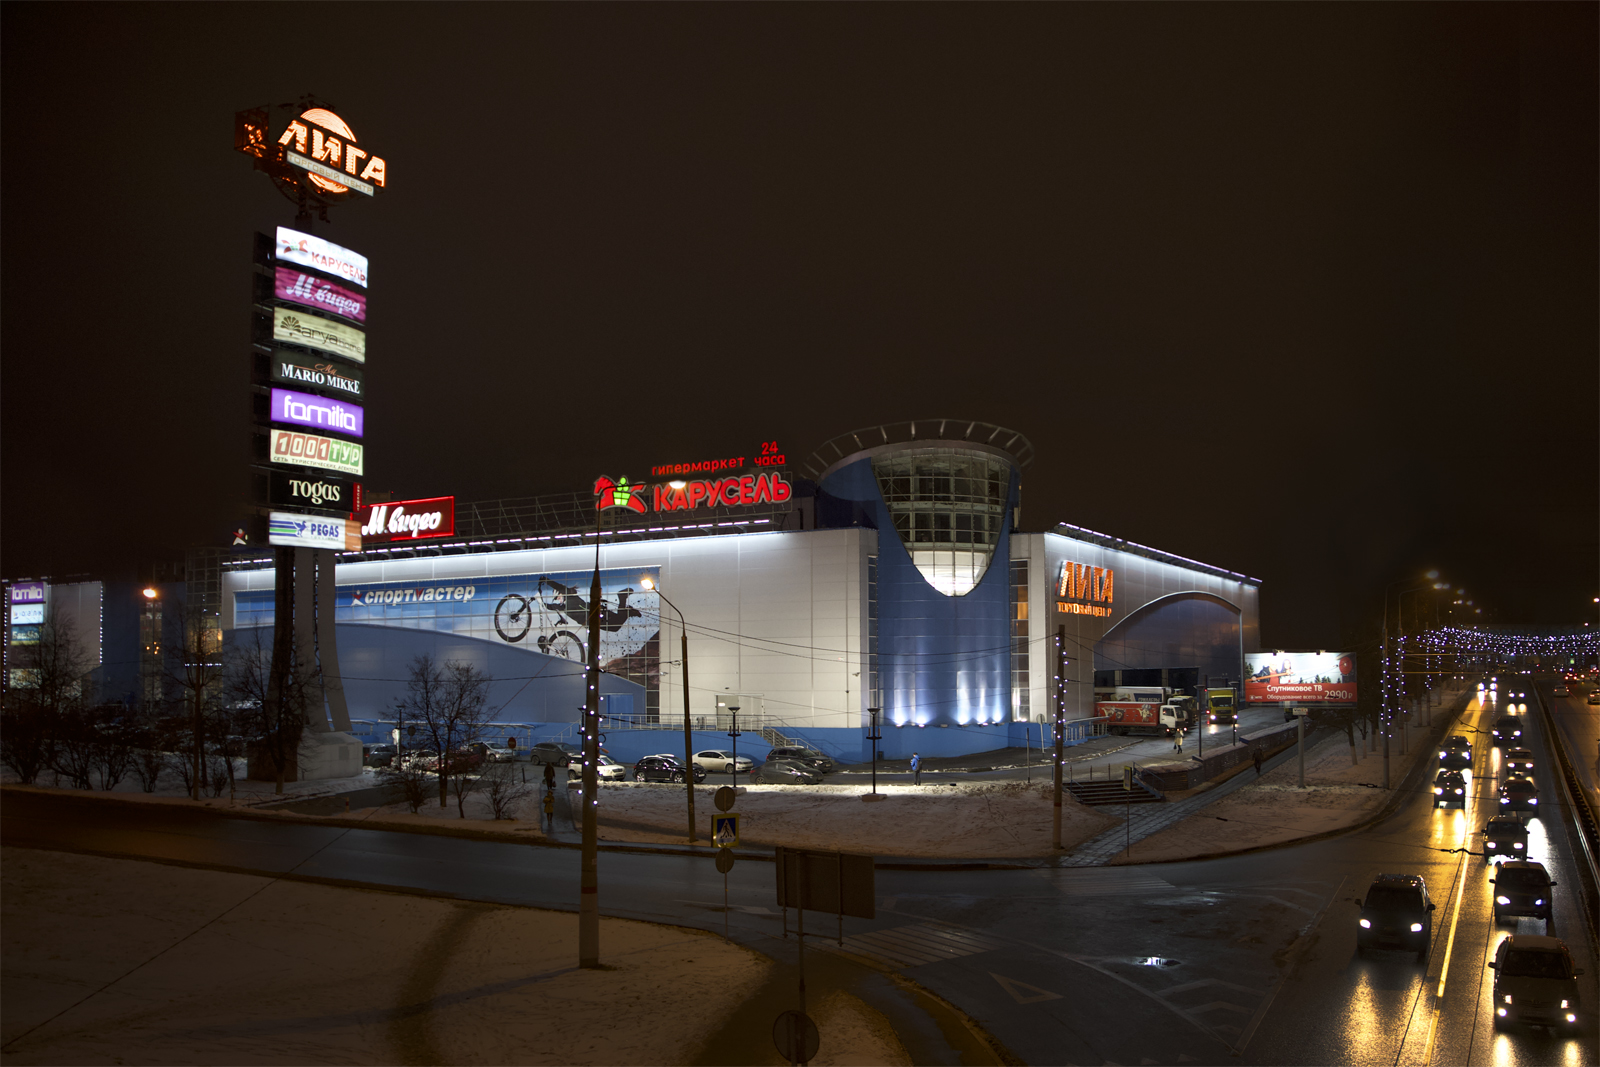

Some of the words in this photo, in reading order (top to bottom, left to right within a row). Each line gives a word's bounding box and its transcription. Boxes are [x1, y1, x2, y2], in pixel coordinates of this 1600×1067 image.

[277, 119, 387, 188] ЛИГА
[286, 153, 340, 181] ТОРГОВЫЙ
[343, 177, 373, 193] ЦЕНТР
[311, 251, 366, 282] КАРУСЕЛЬ
[326, 374, 360, 395] MIKKE
[283, 395, 357, 431] familia
[761, 441, 779, 455] 24
[652, 456, 745, 476] гипермаркет
[754, 453, 786, 467] часа
[654, 473, 792, 513] КАРУСЕЛЬ
[310, 523, 339, 538] PEGAS
[1058, 560, 1114, 604] ЛИГА
[364, 584, 476, 606] спортмастер
[1266, 684, 1312, 694] Спутниковое
[1313, 684, 1323, 692] ТВ
[1324, 689, 1348, 700] 2990
